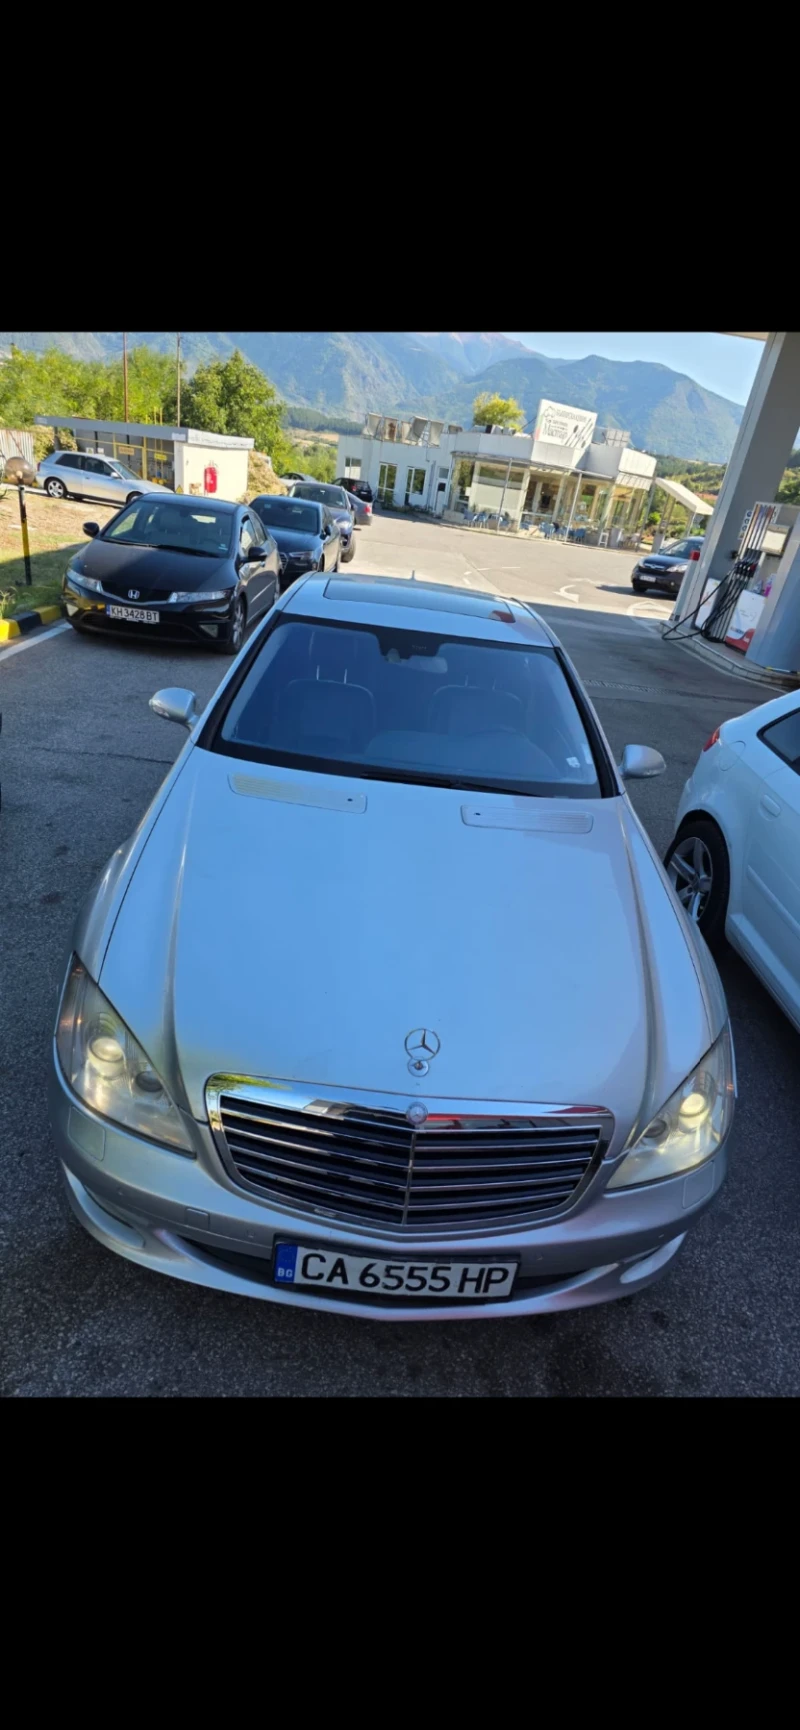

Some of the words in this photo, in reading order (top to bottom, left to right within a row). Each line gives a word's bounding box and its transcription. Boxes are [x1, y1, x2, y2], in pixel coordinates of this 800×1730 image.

[111, 606, 122, 616] KH
[124, 608, 145, 619] 3428
[146, 611, 157, 621] BT
[277, 1267, 293, 1279] BG
[301, 1253, 349, 1285] CA
[359, 1262, 452, 1293] 6555
[457, 1266, 509, 1294] HP
